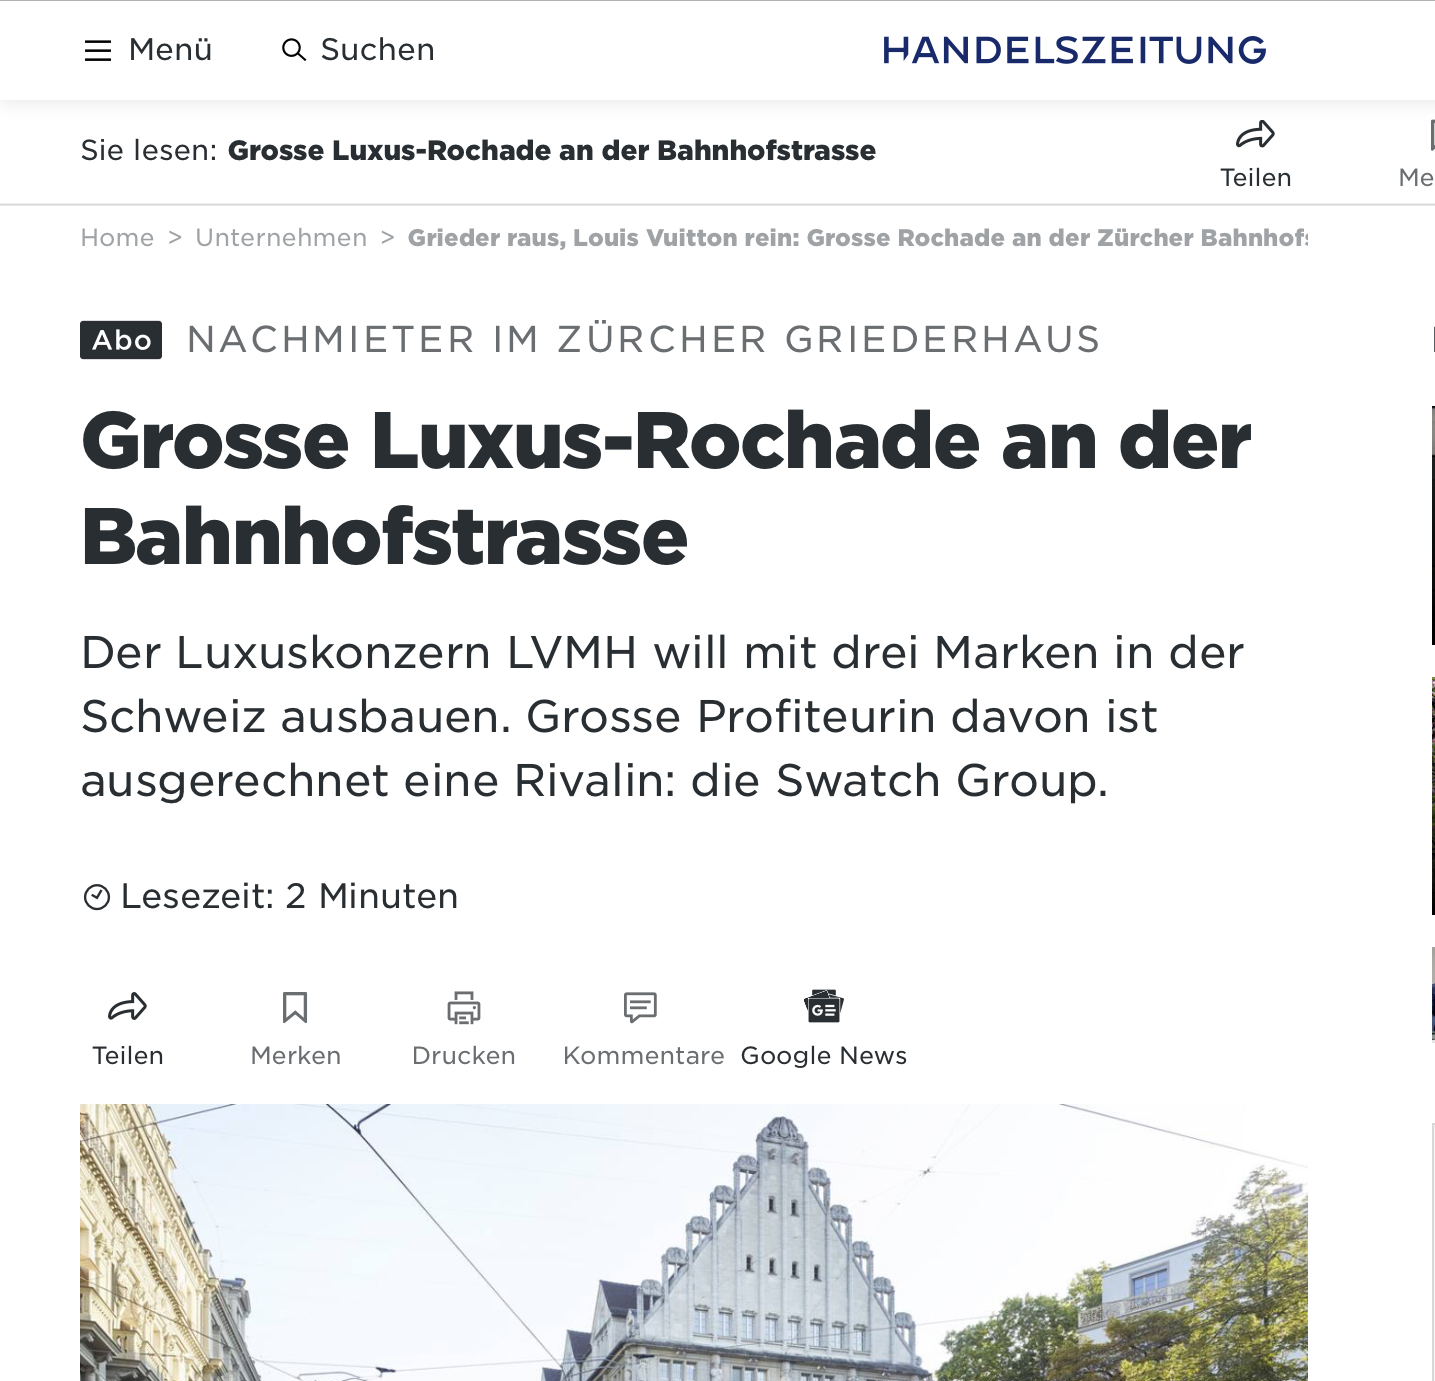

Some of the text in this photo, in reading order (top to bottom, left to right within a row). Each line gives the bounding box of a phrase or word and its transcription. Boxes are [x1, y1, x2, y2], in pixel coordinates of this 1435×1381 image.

[130, 37, 212, 62] Menü
[321, 36, 434, 62] Suchen
[883, 35, 1267, 65] HANDELSZEITUNG
[81, 137, 877, 162] Sie lesen: Grosse Luxus-Rochade an der Bahnhofstrasse
[1219, 166, 1291, 188] Teilen
[81, 227, 154, 247] Home
[196, 227, 367, 247] Unternehmen
[407, 227, 501, 247] Grieder
[507, 232, 566, 251] raus,
[573, 227, 639, 247] Louis
[645, 227, 738, 247] Vuitton
[745, 227, 800, 247] rein:
[806, 228, 891, 247] Grosse
[898, 227, 1005, 247] Rochade
[1011, 232, 1042, 247] an
[1048, 227, 1091, 247] der
[1097, 227, 1195, 247] Zürcher
[91, 328, 152, 351] Abo
[189, 319, 1099, 354] NACHMIETER IM ZÜRCHER GRIEDERHAUS
[82, 408, 1252, 470] Grosse Luxus-Rochade an der
[84, 504, 688, 566] Bahnhofstrasse
[83, 633, 1245, 670] Der Luxuskonzern LVMH will mit drei Marken in der
[81, 697, 1158, 734] Schweiz ausbauen. Grosse Profiteurin davon ist
[81, 761, 1107, 805] ausgerechnet eine Rivalin: die Swatch Group.
[122, 881, 458, 910] Lesezeit: 2 Minuten
[91, 1044, 163, 1066] Teilen
[251, 1045, 341, 1065] Merken
[413, 1045, 515, 1065] Drucken
[564, 1045, 725, 1065] Kommentare
[740, 1044, 907, 1069] Google News
